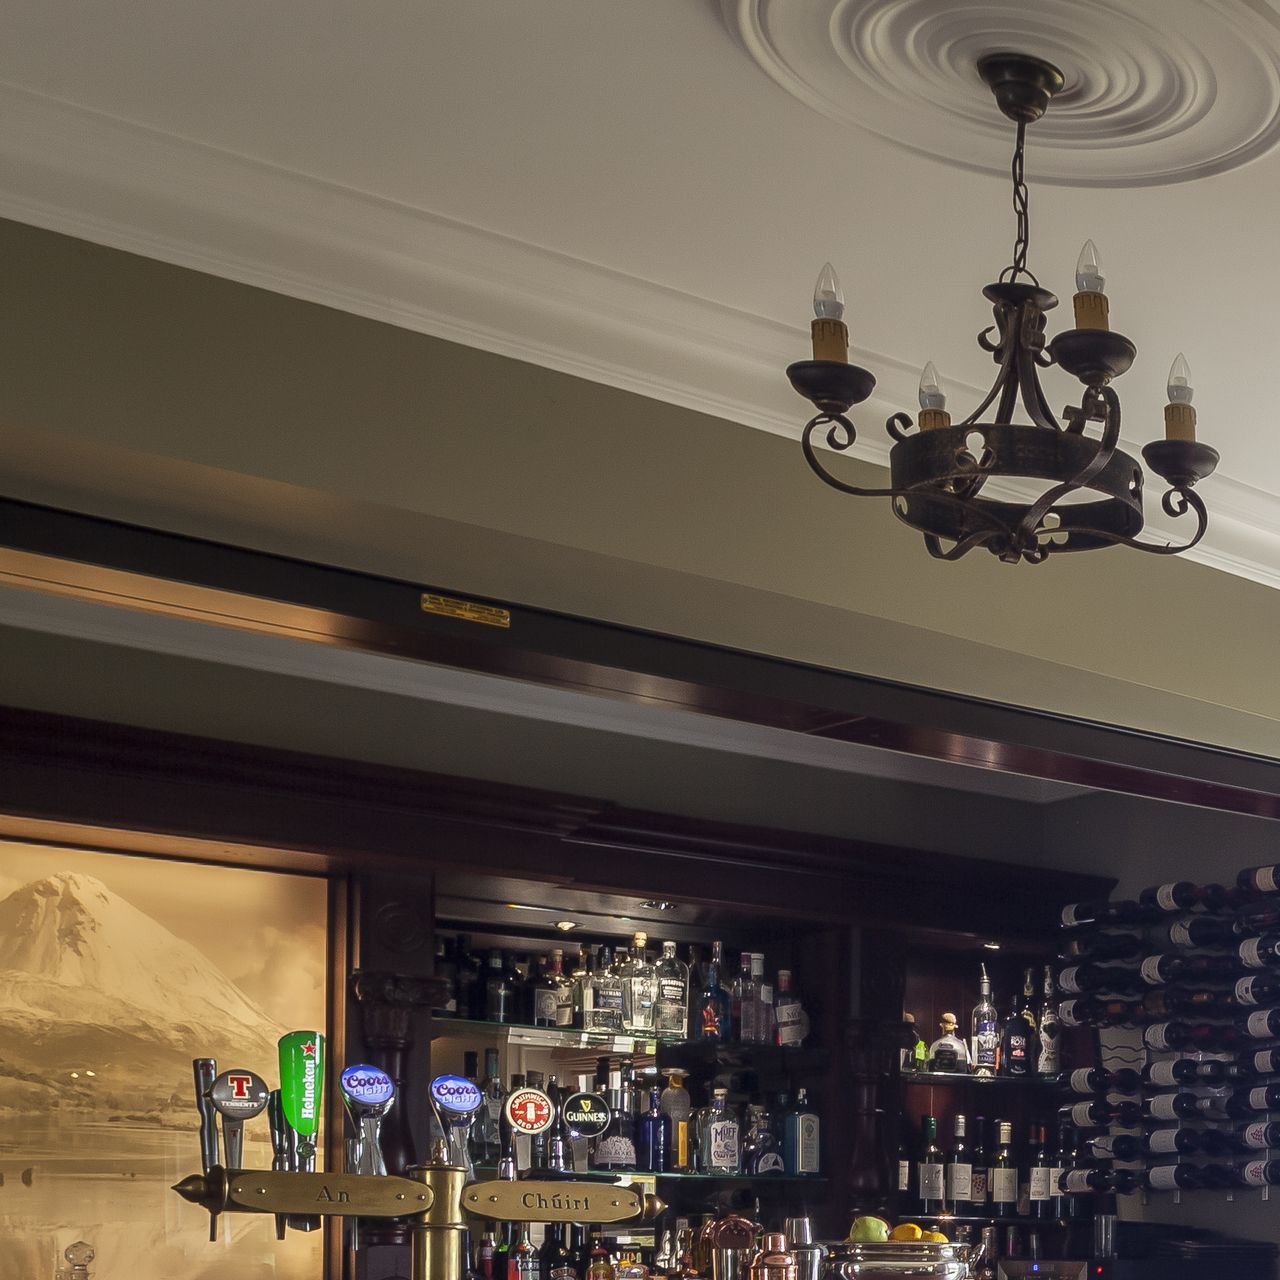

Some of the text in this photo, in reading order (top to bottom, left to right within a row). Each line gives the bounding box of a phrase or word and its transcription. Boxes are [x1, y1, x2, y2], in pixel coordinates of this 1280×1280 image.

[228, 1075, 252, 1099] T
[345, 1074, 390, 1088] Coors
[301, 1060, 315, 1119] Heineken
[353, 1084, 390, 1096] LIGHT
[435, 1083, 478, 1096] Coors
[442, 1094, 478, 1103] LIGHT
[566, 1111, 608, 1122] GUINNESS
[517, 1118, 532, 1129] RED
[316, 1185, 351, 1203] An
[521, 1192, 590, 1211] Chúirt
